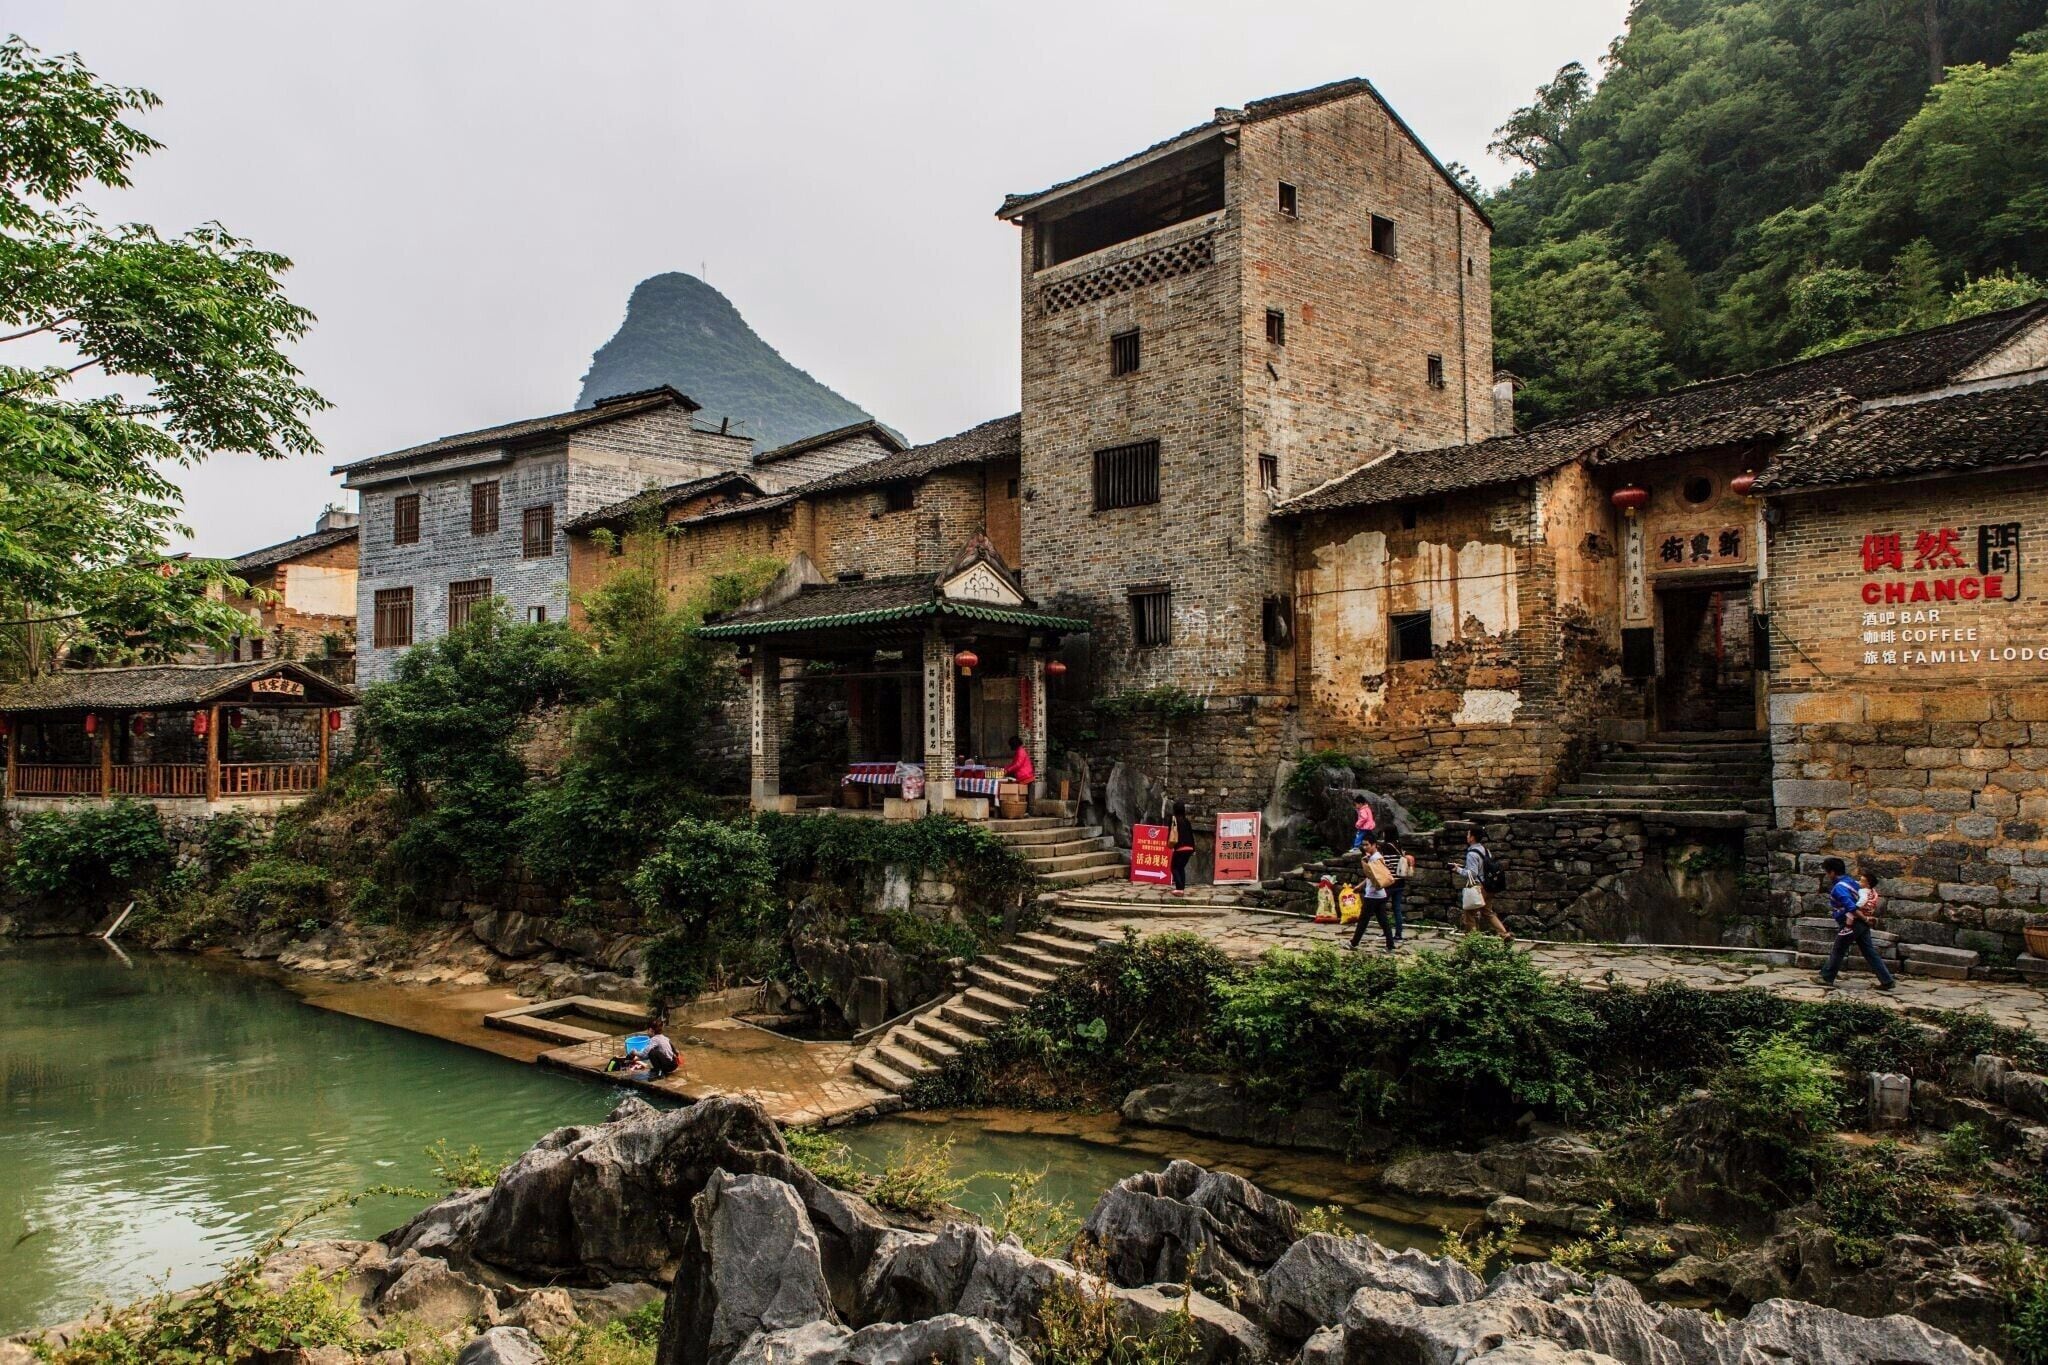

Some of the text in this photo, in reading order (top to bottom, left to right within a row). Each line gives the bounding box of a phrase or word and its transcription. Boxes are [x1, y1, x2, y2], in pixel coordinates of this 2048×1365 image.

[1861, 576, 2003, 604] CHANCE
[1862, 610, 1941, 626] 酒吧 BAR
[1864, 628, 1978, 643] 咖啡 COFFEE
[1864, 651, 1897, 664] 旅馆
[1903, 649, 1981, 663] FAMILY
